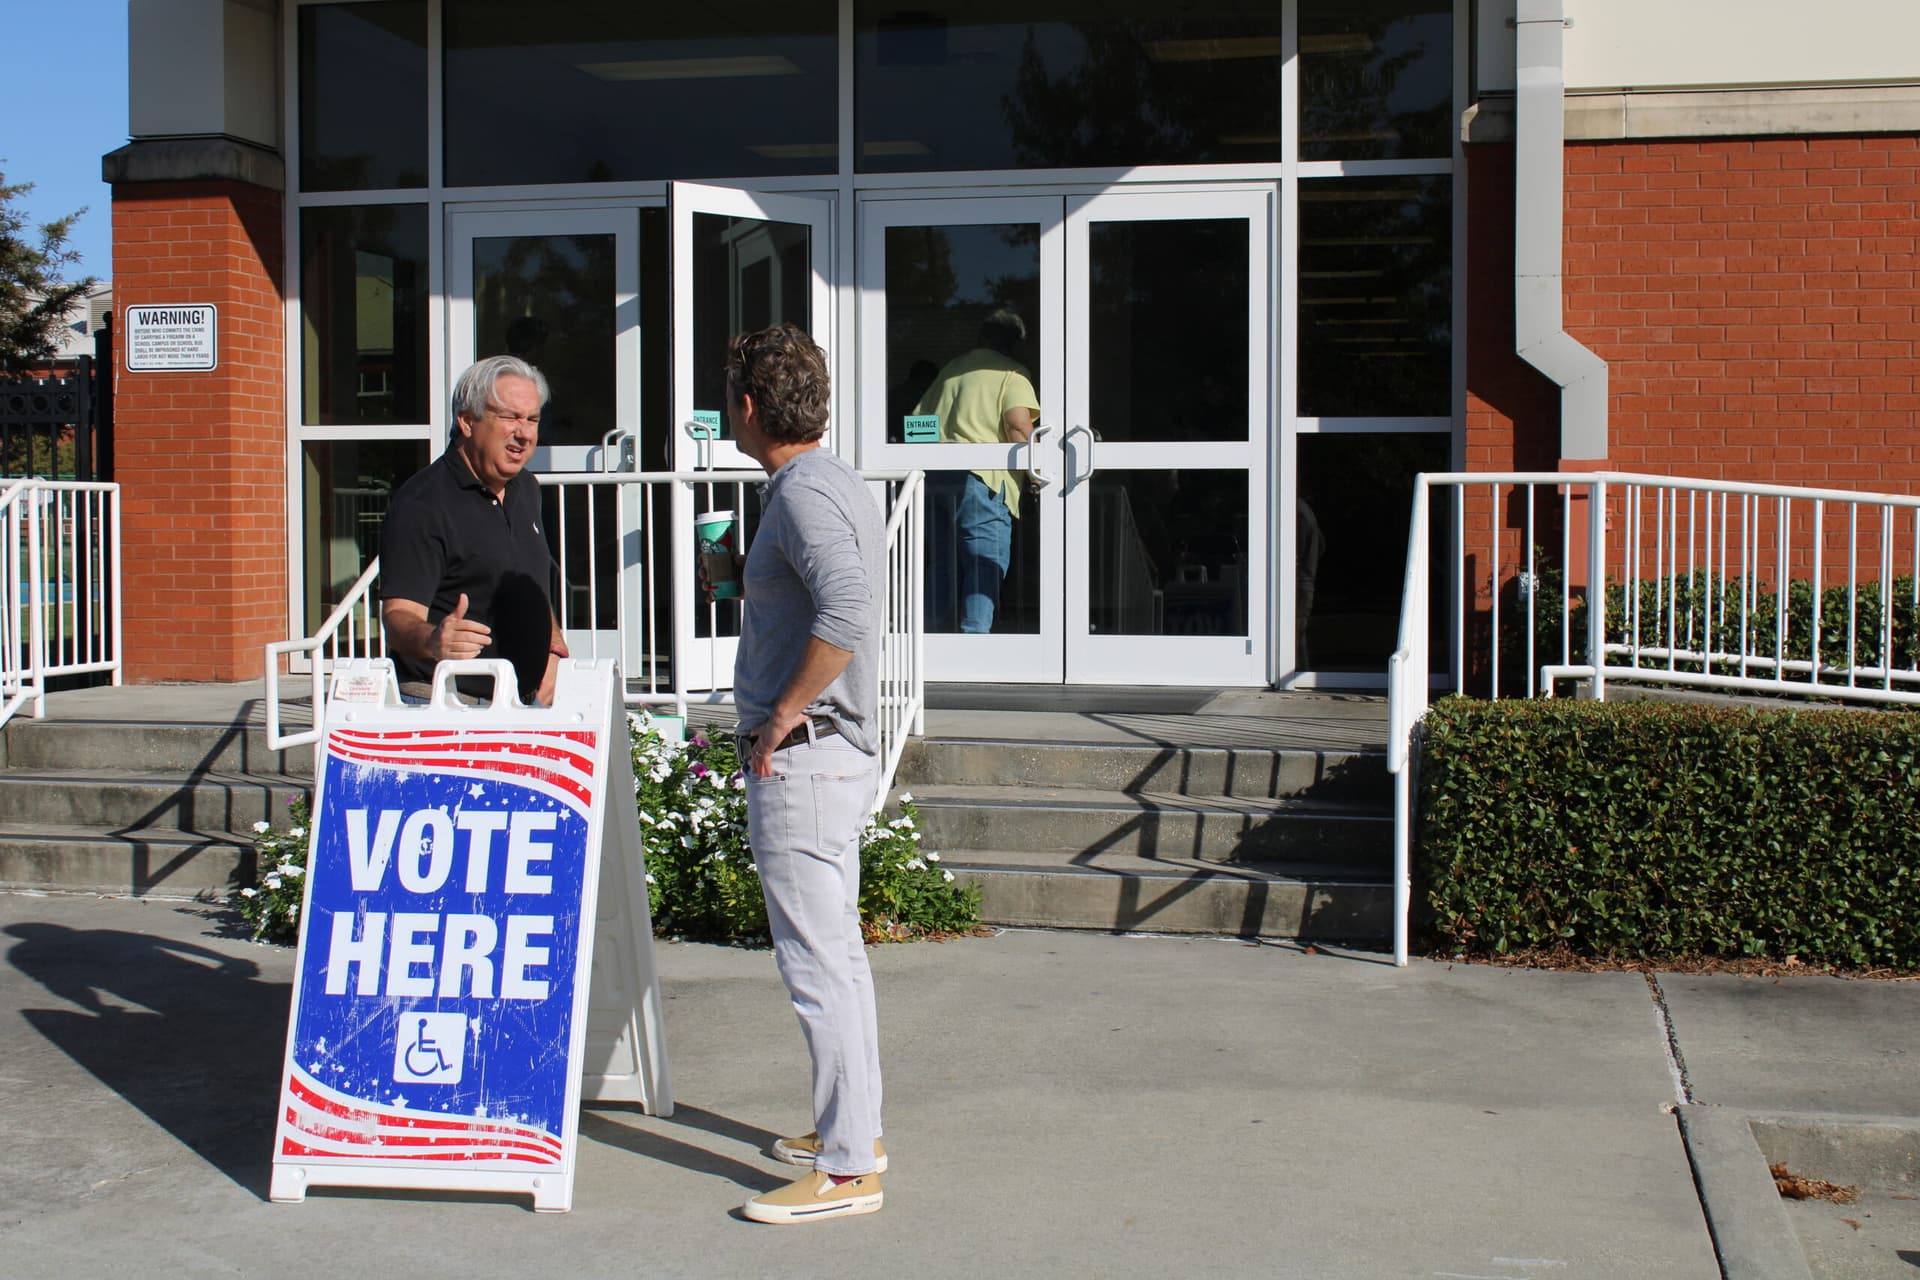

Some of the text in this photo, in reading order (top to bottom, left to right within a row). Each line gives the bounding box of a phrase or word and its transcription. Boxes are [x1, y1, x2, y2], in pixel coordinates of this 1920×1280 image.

[139, 310, 205, 325] WARNING!
[693, 416, 718, 424] ENTRANCE
[906, 420, 937, 429] ENTRANCE
[345, 808, 557, 894] VOTE
[325, 911, 554, 1000] HERE
